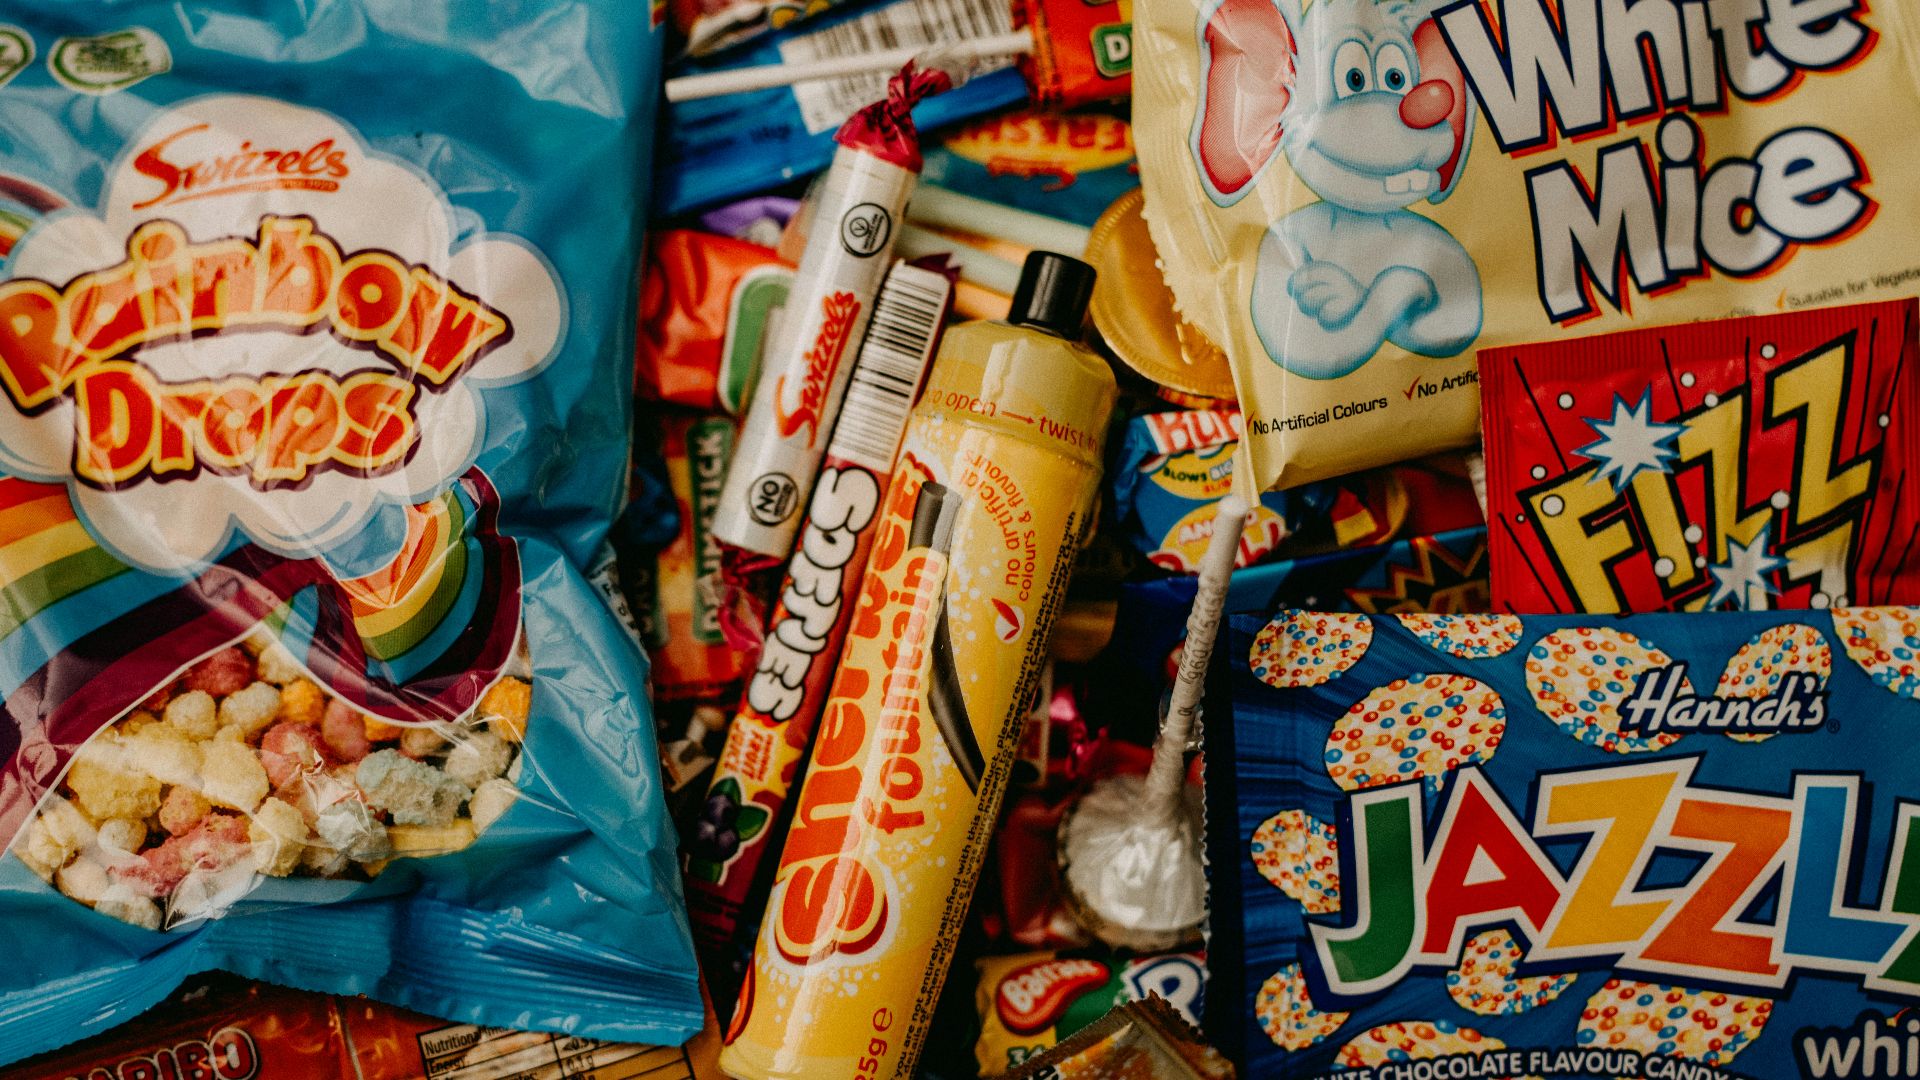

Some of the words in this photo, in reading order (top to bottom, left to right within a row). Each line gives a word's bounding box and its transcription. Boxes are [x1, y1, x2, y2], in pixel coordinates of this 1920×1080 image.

[132, 123, 349, 210] Swizzels
[1527, 114, 1874, 322] Mice
[0, 217, 507, 412] Rainbow
[775, 291, 855, 448] Swizzels
[1417, 382, 1437, 399] No
[78, 363, 414, 486] Drops
[945, 392, 997, 418] open
[1039, 415, 1086, 448] twist
[1253, 419, 1270, 436] No
[1270, 412, 1330, 433] Artificial
[1332, 396, 1389, 421] Colours
[965, 449, 1025, 509] flavours
[1163, 466, 1208, 483] BLOWS
[1520, 332, 1878, 613] FIZZ
[756, 479, 780, 514] NO
[960, 468, 1021, 551] artificial
[1018, 510, 1032, 524] &
[1061, 506, 1076, 539] with
[1005, 557, 1021, 587] no
[1018, 530, 1036, 602] colours
[749, 466, 881, 722] SOFTIES
[1034, 588, 1050, 624] pack
[1024, 625, 1039, 651] the
[861, 552, 940, 837] fountain
[1011, 652, 1030, 699] return
[1626, 664, 1825, 731] Hannah's
[778, 453, 932, 962] Sherbet
[995, 700, 1017, 748] please
[964, 812, 981, 841] this
[953, 842, 973, 875] with
[963, 847, 980, 876] was
[936, 876, 961, 938] satisfied
[945, 890, 965, 935] where
[918, 938, 943, 994] entirely
[934, 937, 951, 964] and
[908, 995, 925, 1022] not
[921, 967, 942, 1006] when
[900, 1023, 916, 1048] are
[915, 1006, 929, 1024] of
[891, 1050, 910, 1079] you
[901, 1025, 923, 1074] details
[1381, 1054, 1523, 1080] CHOCOLATE
[1529, 1051, 1638, 1076] FLAVOUR
